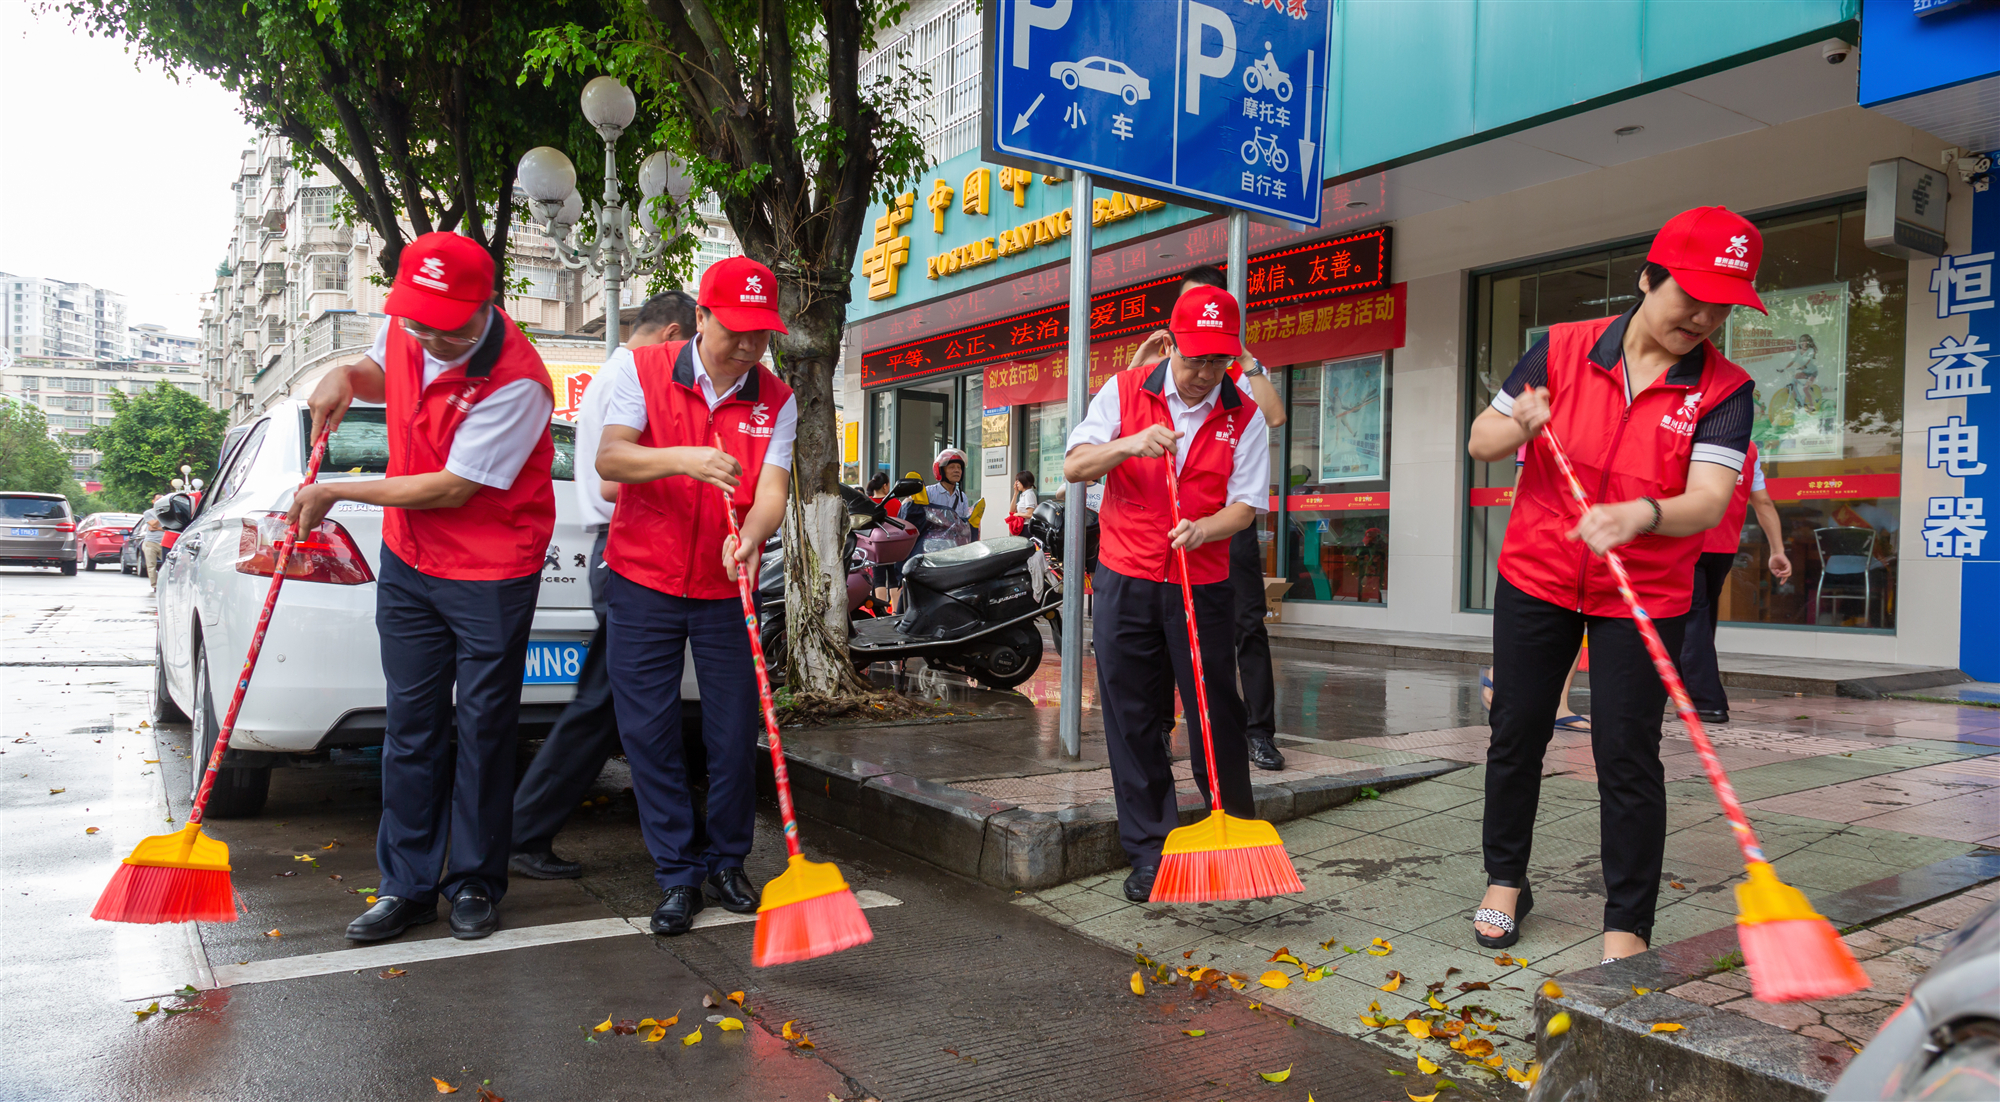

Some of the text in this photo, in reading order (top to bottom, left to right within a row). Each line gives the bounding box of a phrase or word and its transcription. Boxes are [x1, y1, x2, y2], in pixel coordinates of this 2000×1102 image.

[1013, 0, 1073, 70] P
[1185, 0, 1237, 116] P
[1242, 97, 1291, 128] 摩托车
[1241, 171, 1287, 200] 自行车
[926, 236, 998, 280] POSTAL
[1921, 252, 1996, 557] 恒益电器
[540, 576, 577, 584] GEOT
